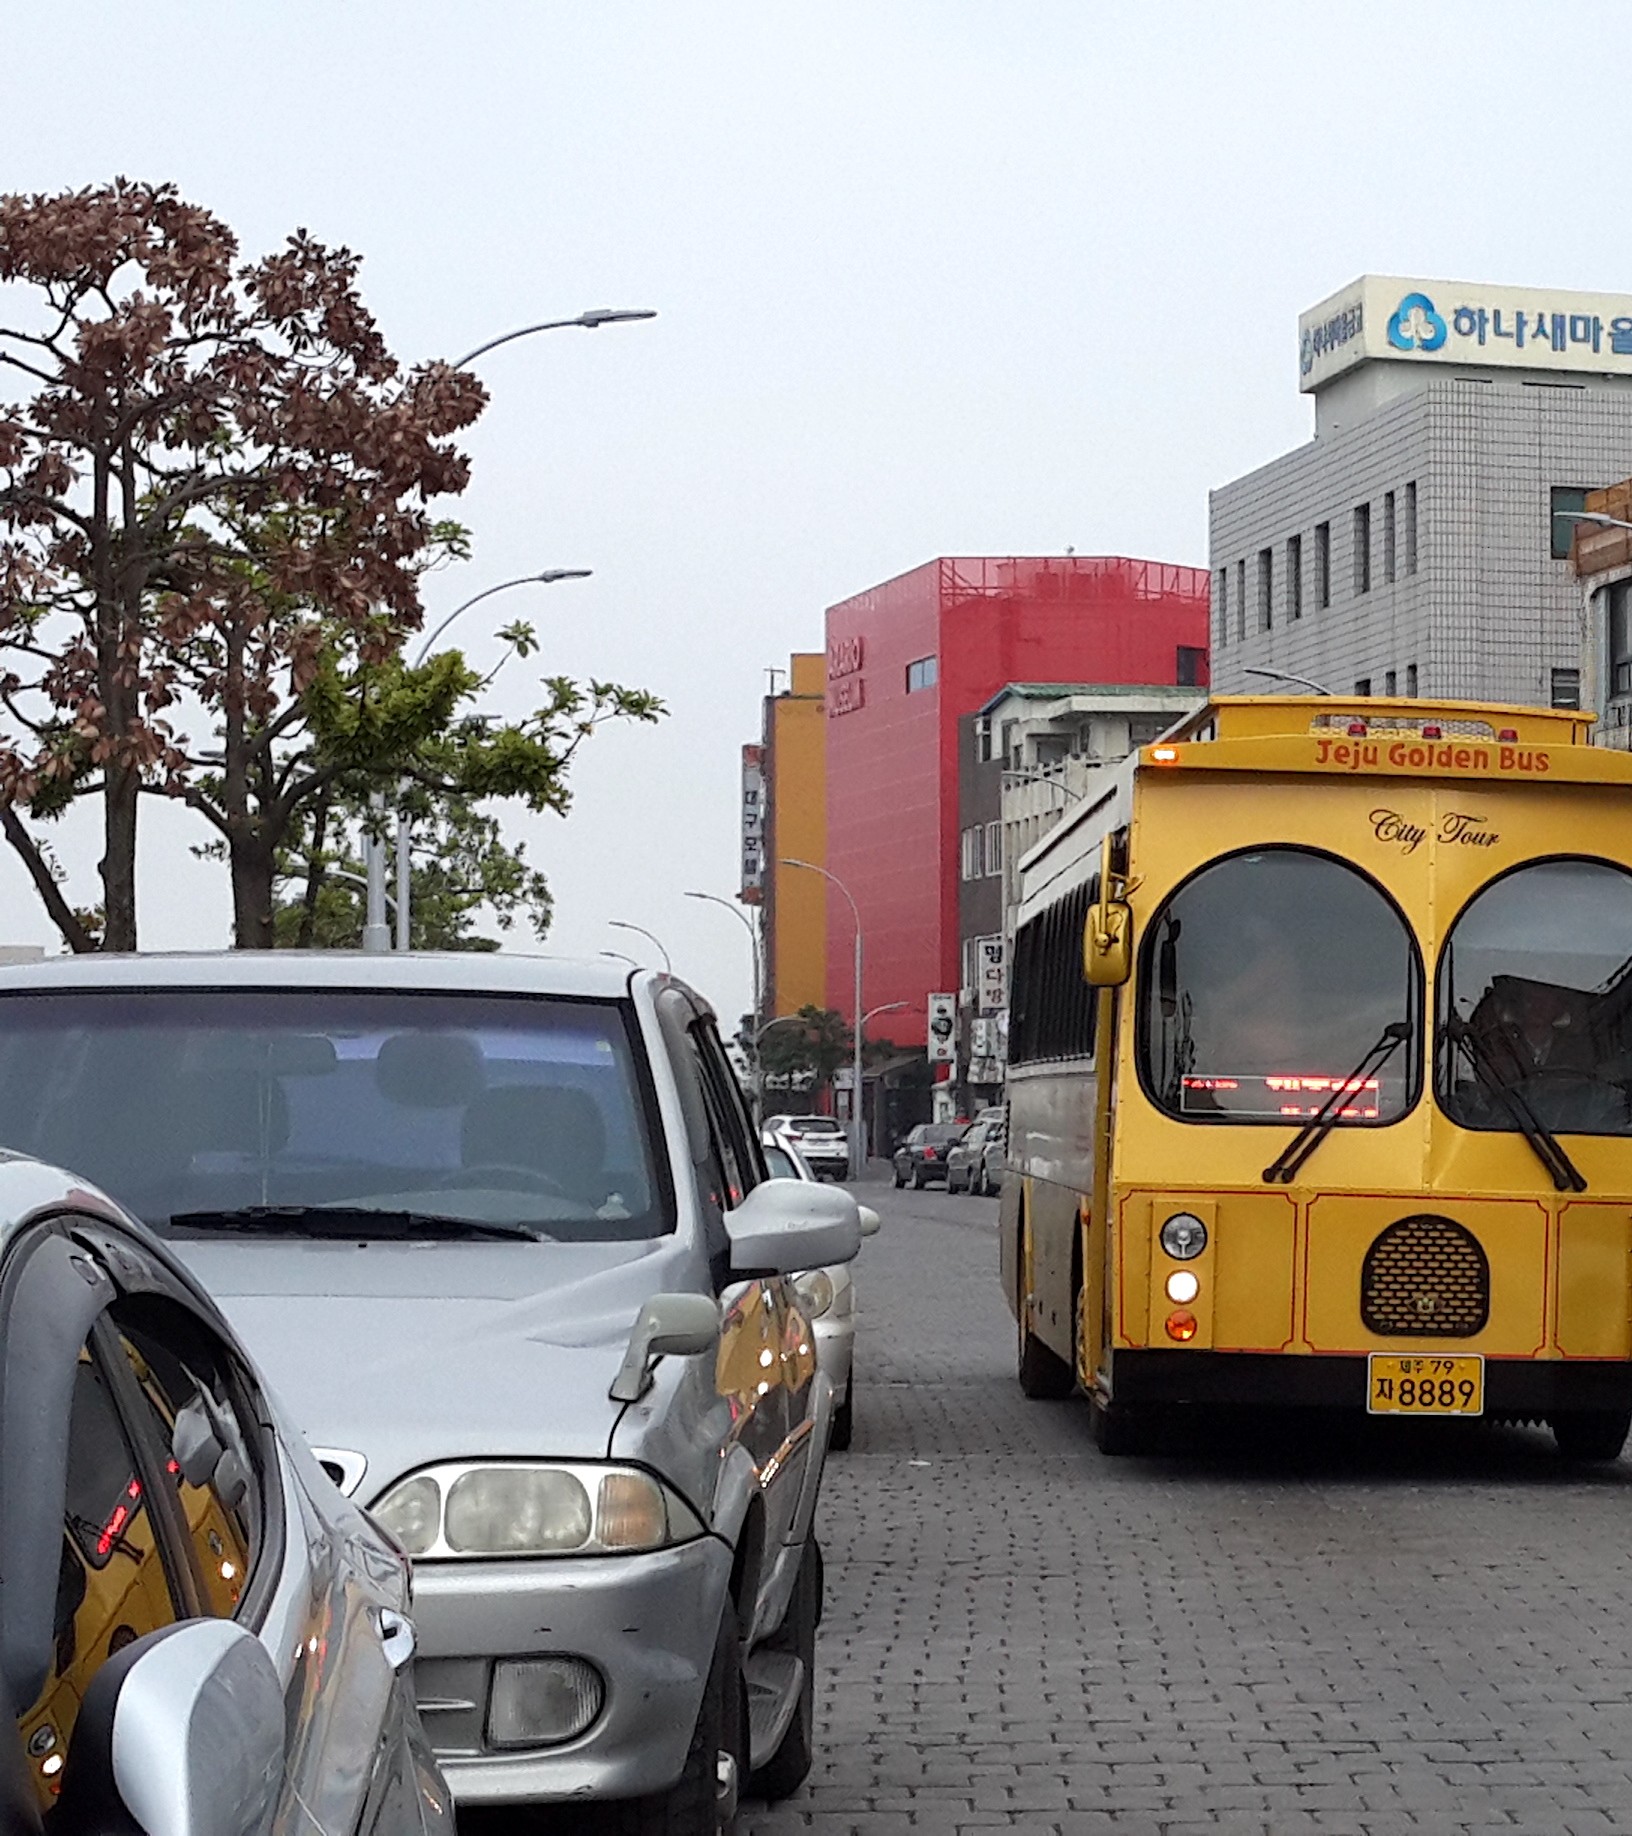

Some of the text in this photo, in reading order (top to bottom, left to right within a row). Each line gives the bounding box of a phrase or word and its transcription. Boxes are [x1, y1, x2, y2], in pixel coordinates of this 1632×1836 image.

[1315, 740, 1551, 772] Jeju Golden Bus
[1368, 809, 1501, 856] City Tour
[1430, 1360, 1455, 1375] 79
